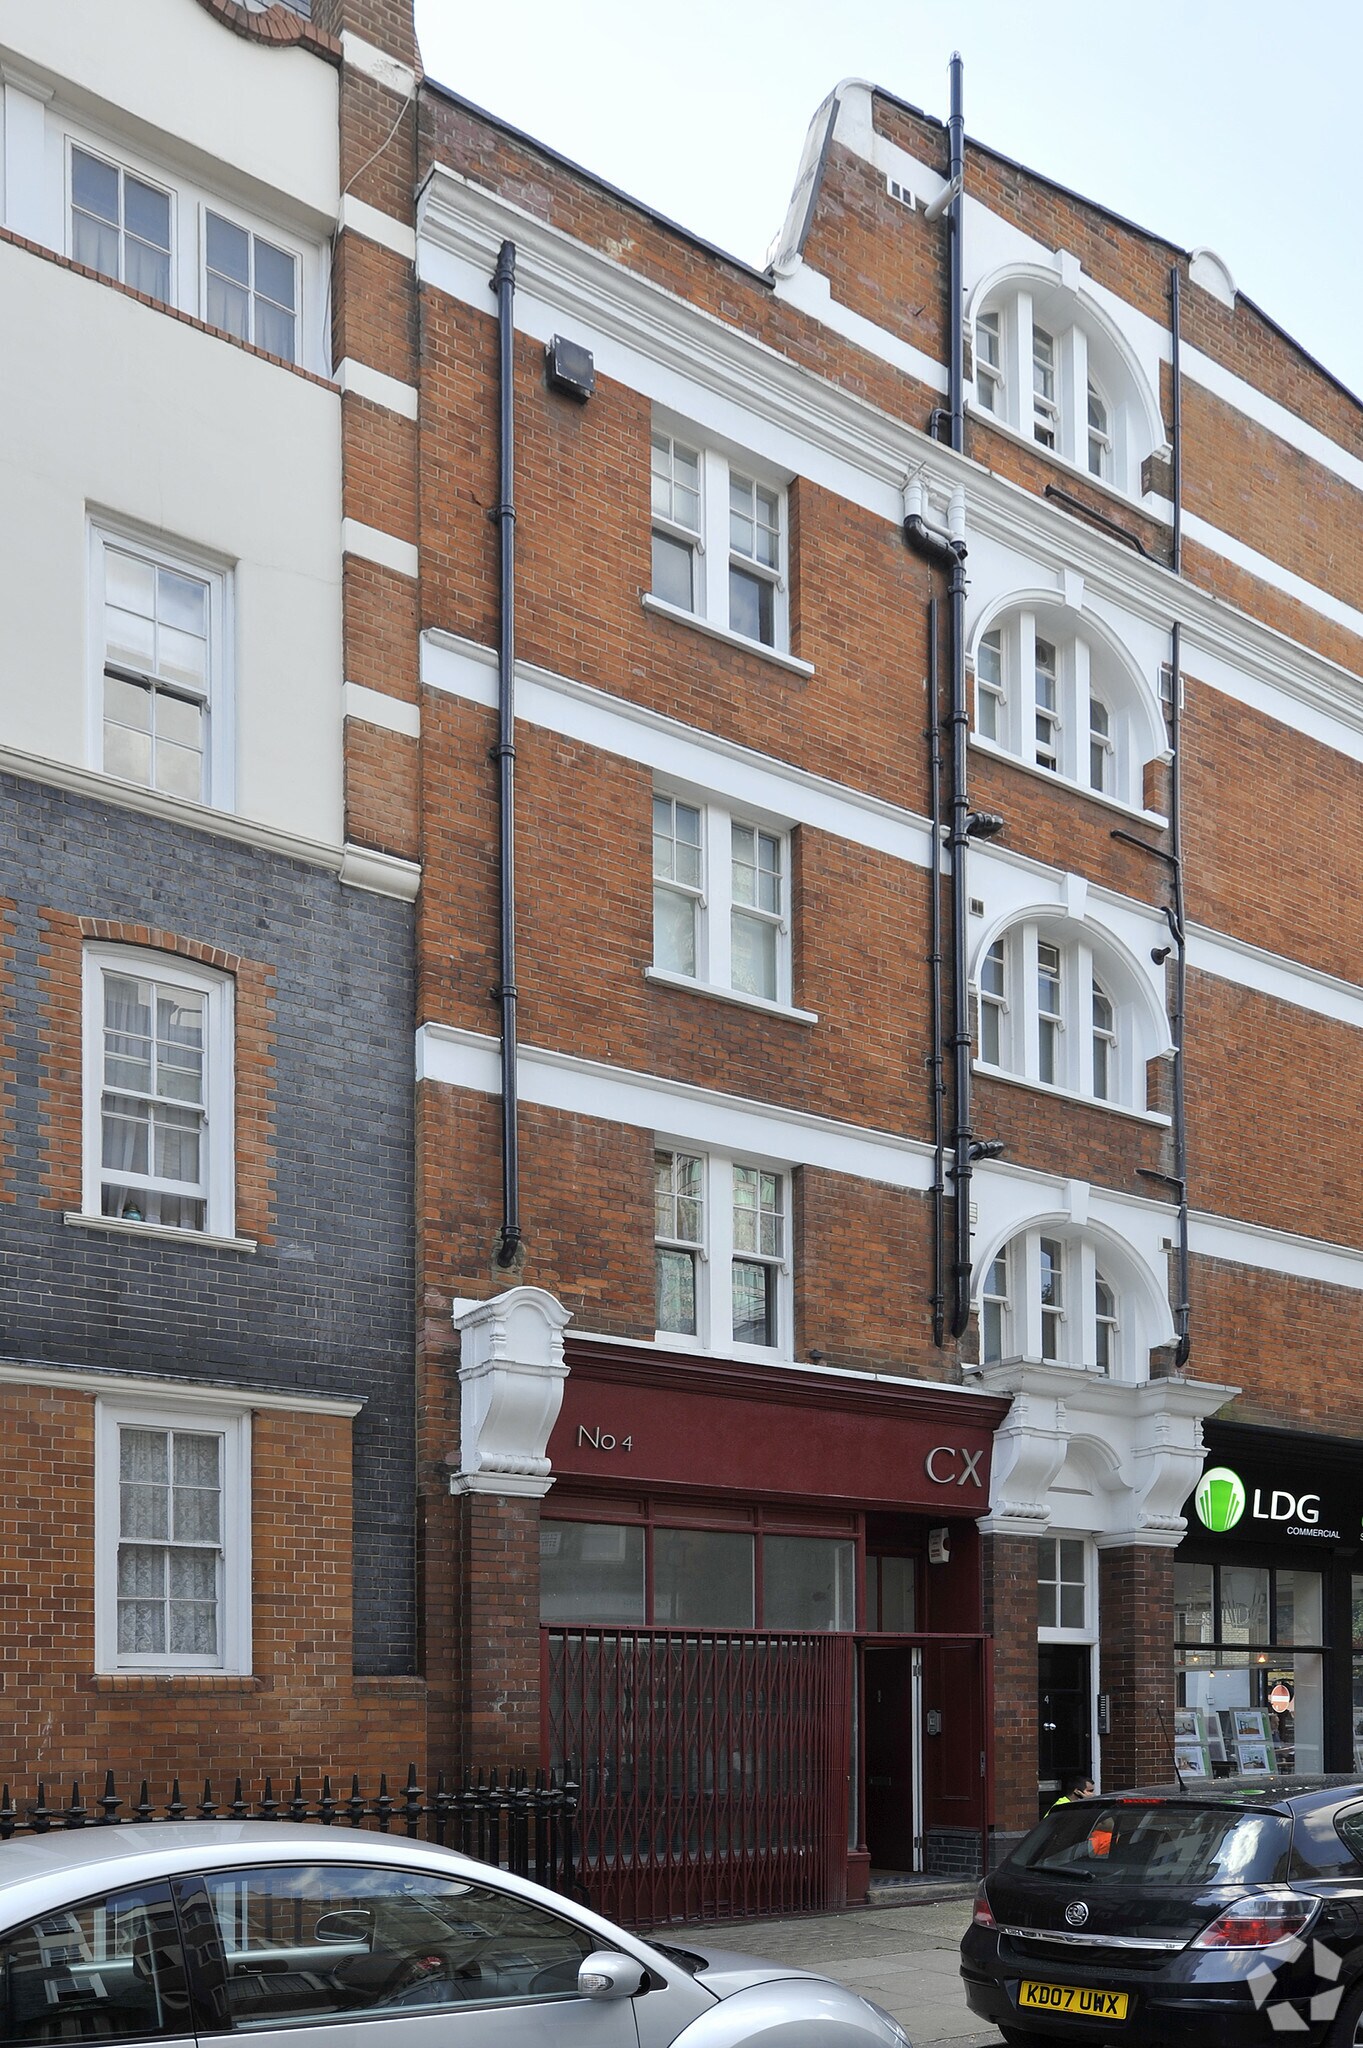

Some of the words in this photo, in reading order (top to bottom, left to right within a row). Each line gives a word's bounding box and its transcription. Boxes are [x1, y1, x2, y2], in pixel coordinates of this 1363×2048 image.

[578, 1424, 616, 1450] No
[621, 1435, 633, 1452] 4
[926, 1446, 984, 1488] CX
[1252, 1488, 1321, 1524] LDG
[1286, 1526, 1341, 1539] COMMERCIAL
[1044, 1695, 1050, 1704] 4
[1026, 1984, 1076, 2008] KD07
[1079, 1991, 1120, 2015] UWX
